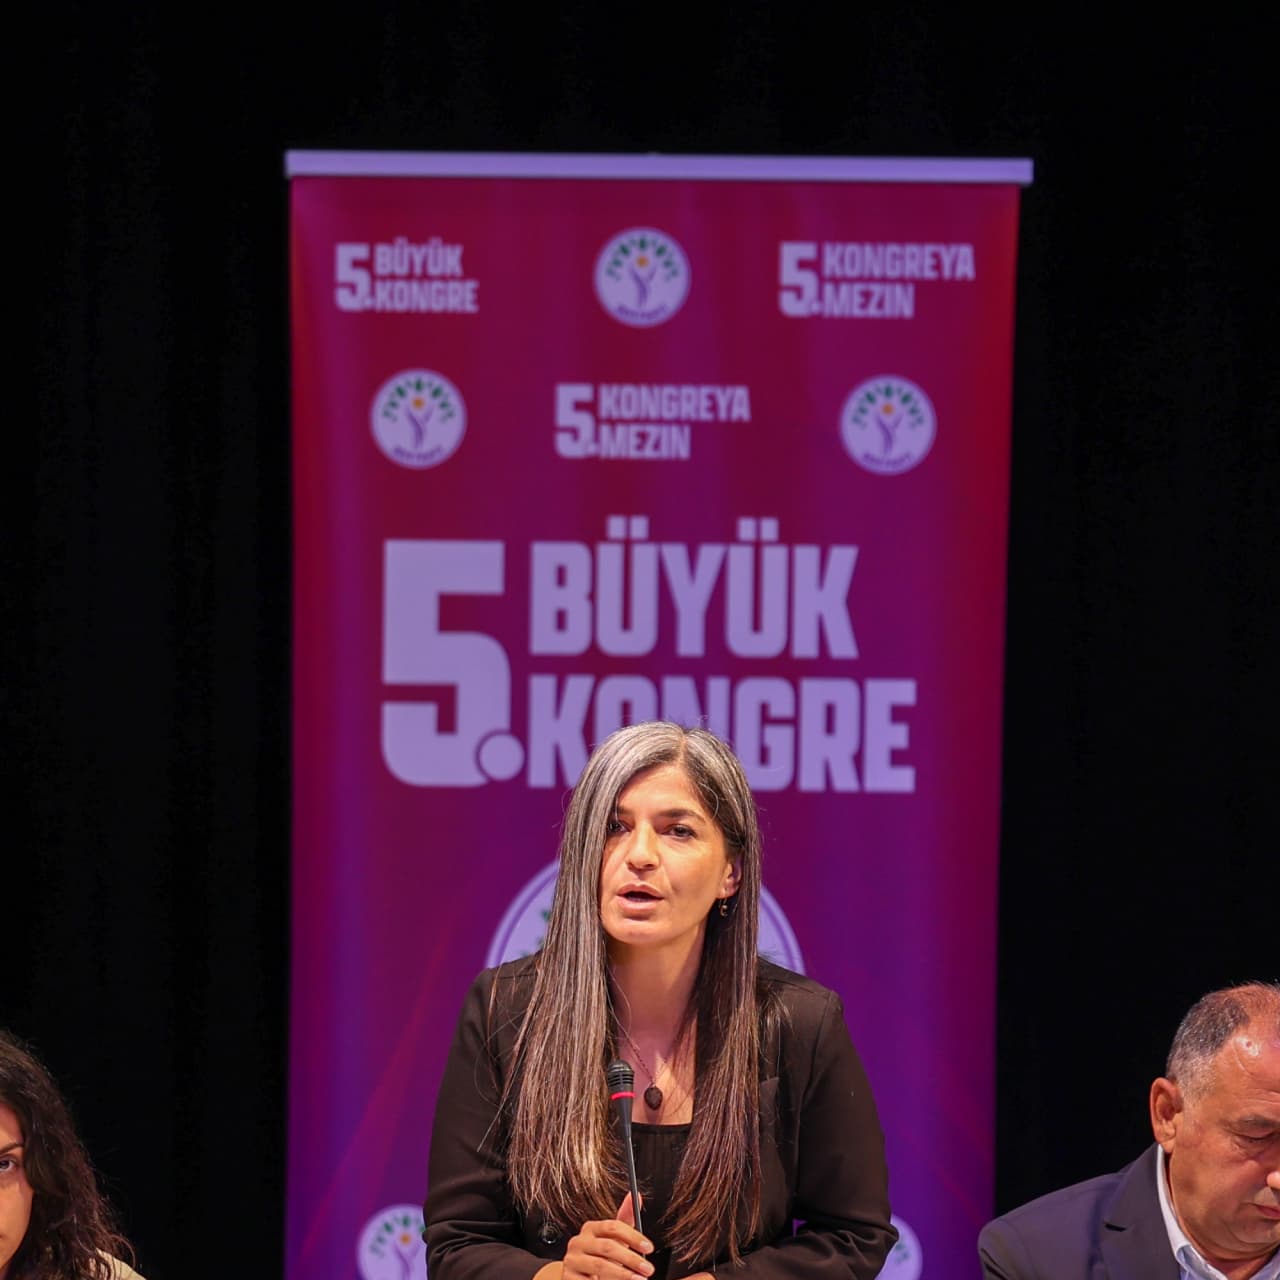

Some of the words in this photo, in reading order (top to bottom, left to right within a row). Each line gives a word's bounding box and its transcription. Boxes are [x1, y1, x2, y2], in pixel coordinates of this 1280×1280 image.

[335, 244, 373, 311] 5.
[374, 238, 463, 277] BÜYÜK
[374, 280, 478, 313] KONGRE
[780, 243, 822, 317] 5.
[823, 243, 975, 280] KONGREYA
[822, 282, 915, 317] MEZIN
[555, 384, 599, 459] 5.
[600, 385, 751, 421] KONGREYA
[600, 423, 691, 460] MEZIN
[381, 540, 524, 787] 5.
[529, 516, 859, 659] BÜYÜK
